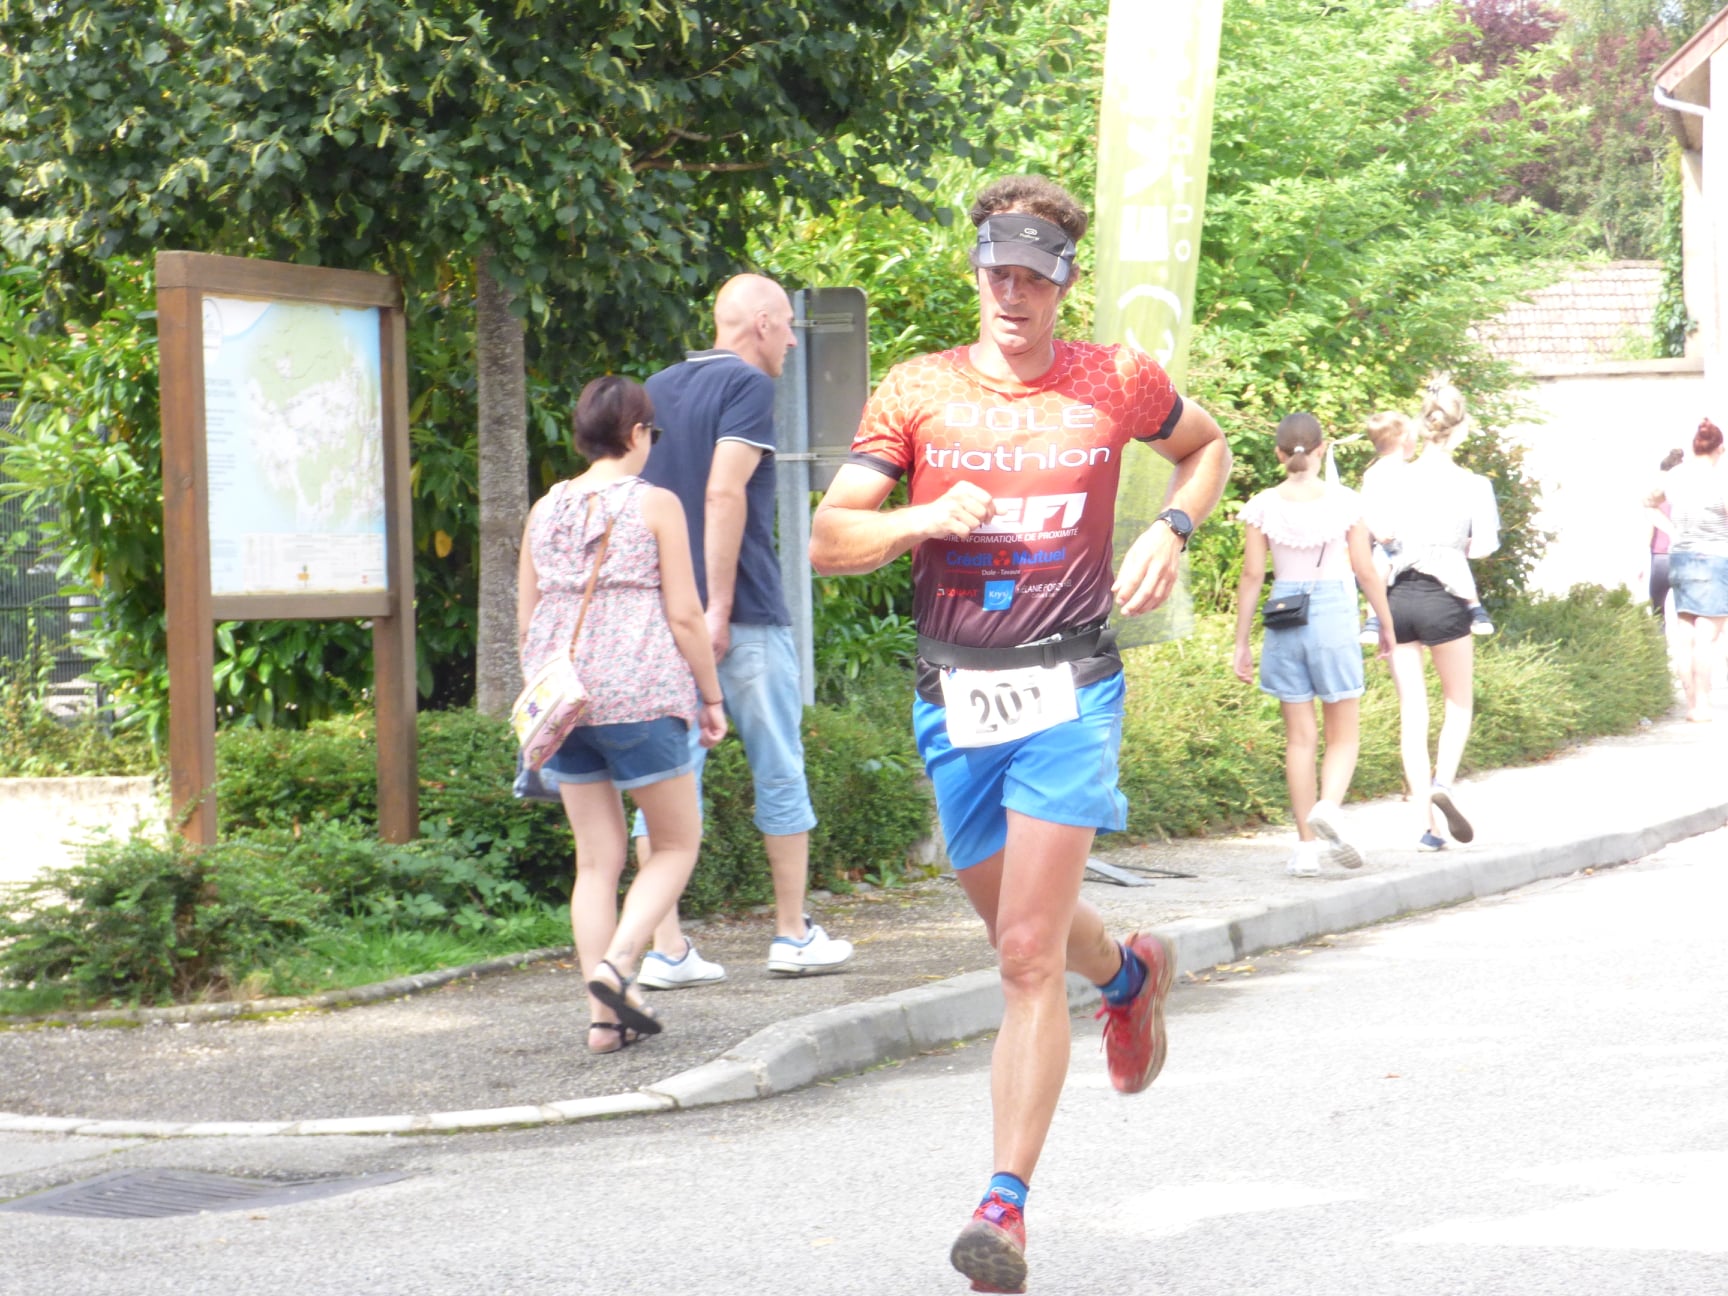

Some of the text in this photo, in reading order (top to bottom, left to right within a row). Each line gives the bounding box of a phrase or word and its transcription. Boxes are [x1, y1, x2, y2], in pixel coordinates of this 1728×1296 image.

[944, 403, 1094, 431] DOLE
[925, 442, 1110, 472] triathlon
[1024, 532, 1036, 541] DE
[946, 545, 1067, 567] Crédit Mutuel
